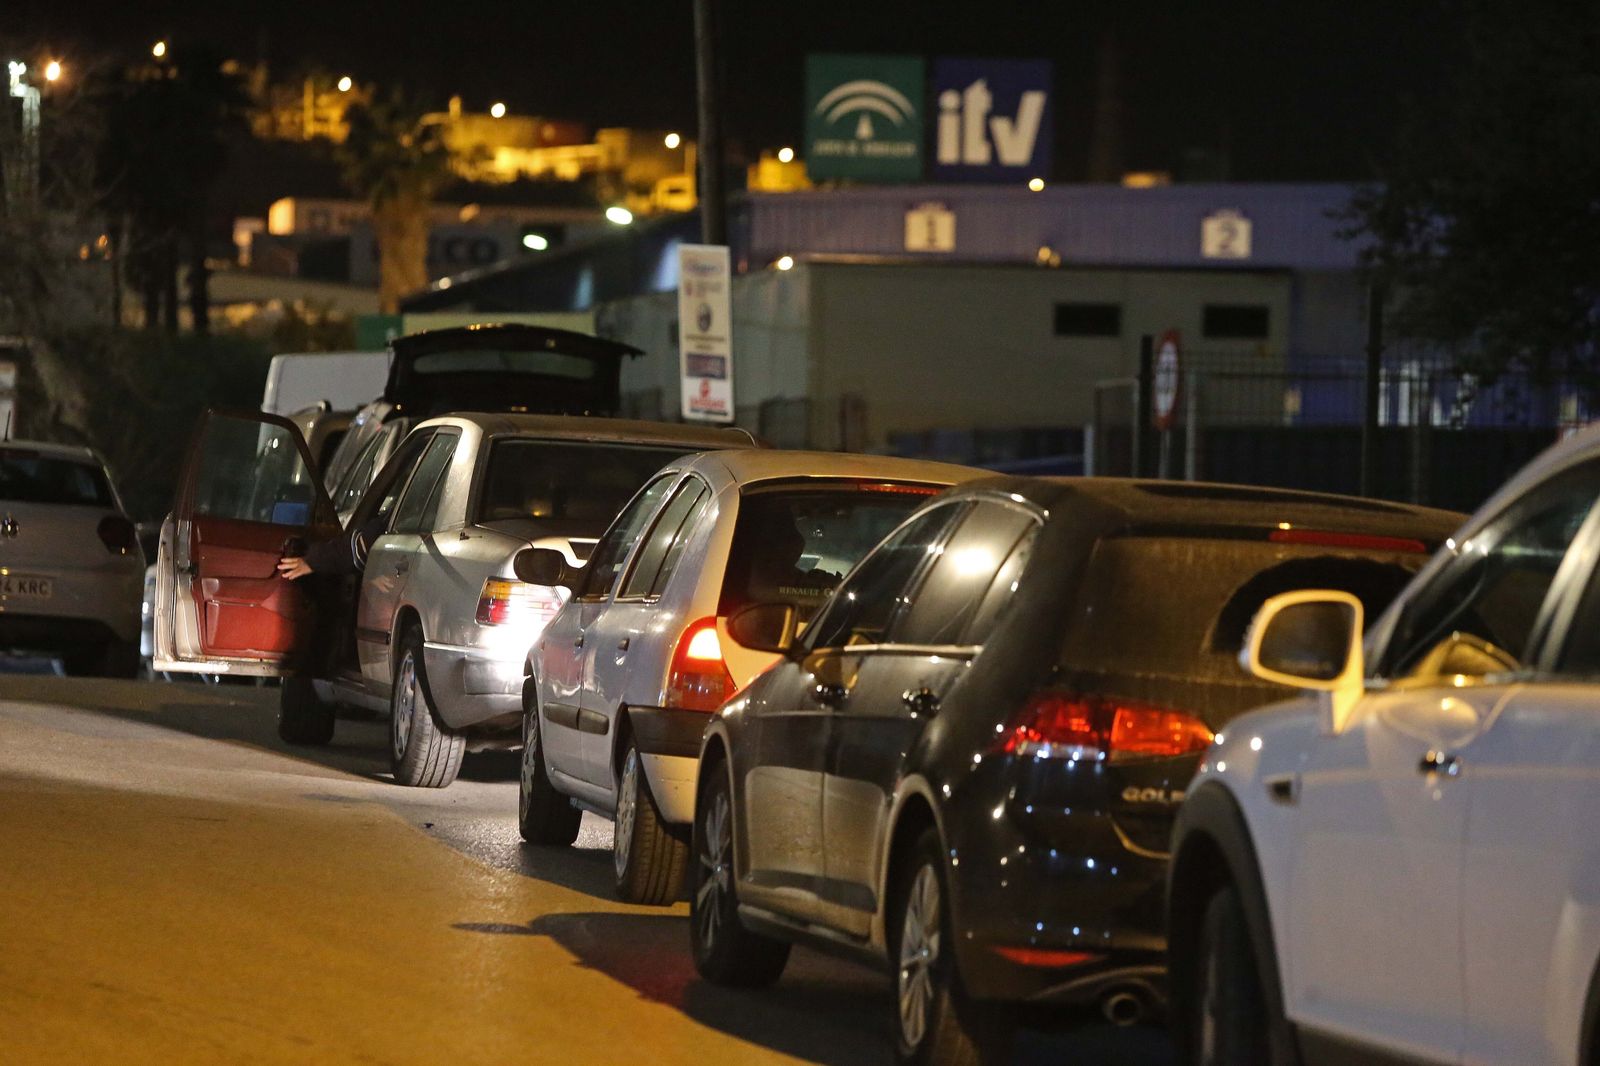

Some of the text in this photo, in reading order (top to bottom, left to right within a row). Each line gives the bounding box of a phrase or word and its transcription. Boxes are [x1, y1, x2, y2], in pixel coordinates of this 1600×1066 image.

[938, 79, 1046, 166] itv
[1219, 221, 1239, 257] 2
[778, 586, 819, 596] RENAULT
